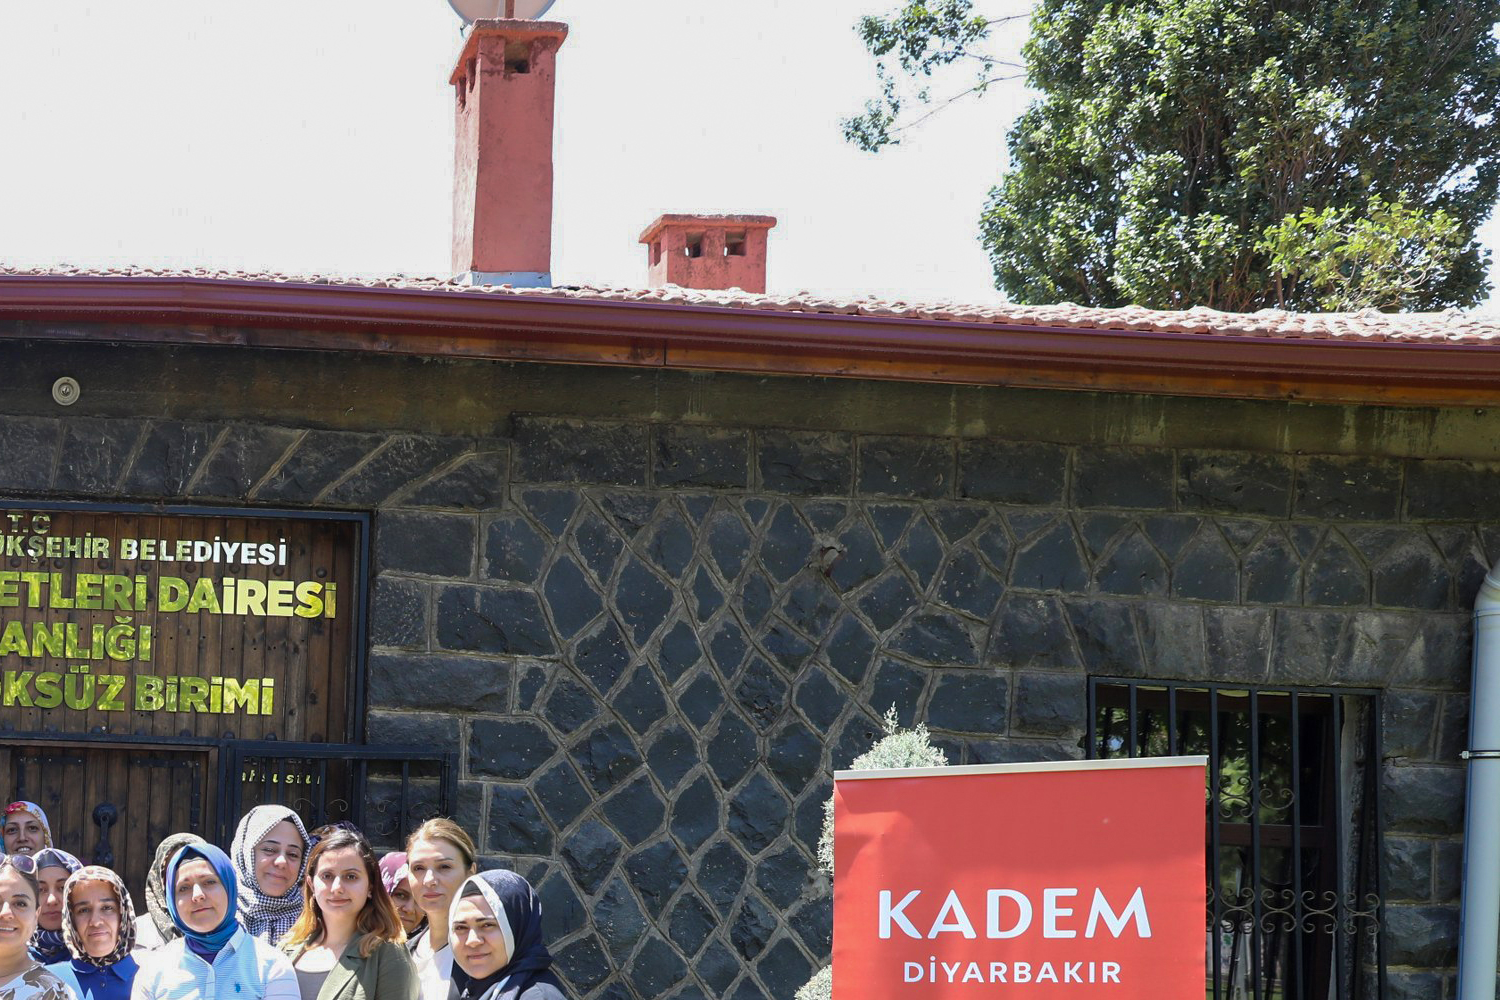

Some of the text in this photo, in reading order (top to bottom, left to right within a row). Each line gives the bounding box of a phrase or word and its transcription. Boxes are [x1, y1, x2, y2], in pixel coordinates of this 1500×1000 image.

[120, 536, 286, 566] BELEDİYESİ
[878, 886, 1152, 939] KADEM
[903, 955, 1121, 984] DİYARBAKIR
